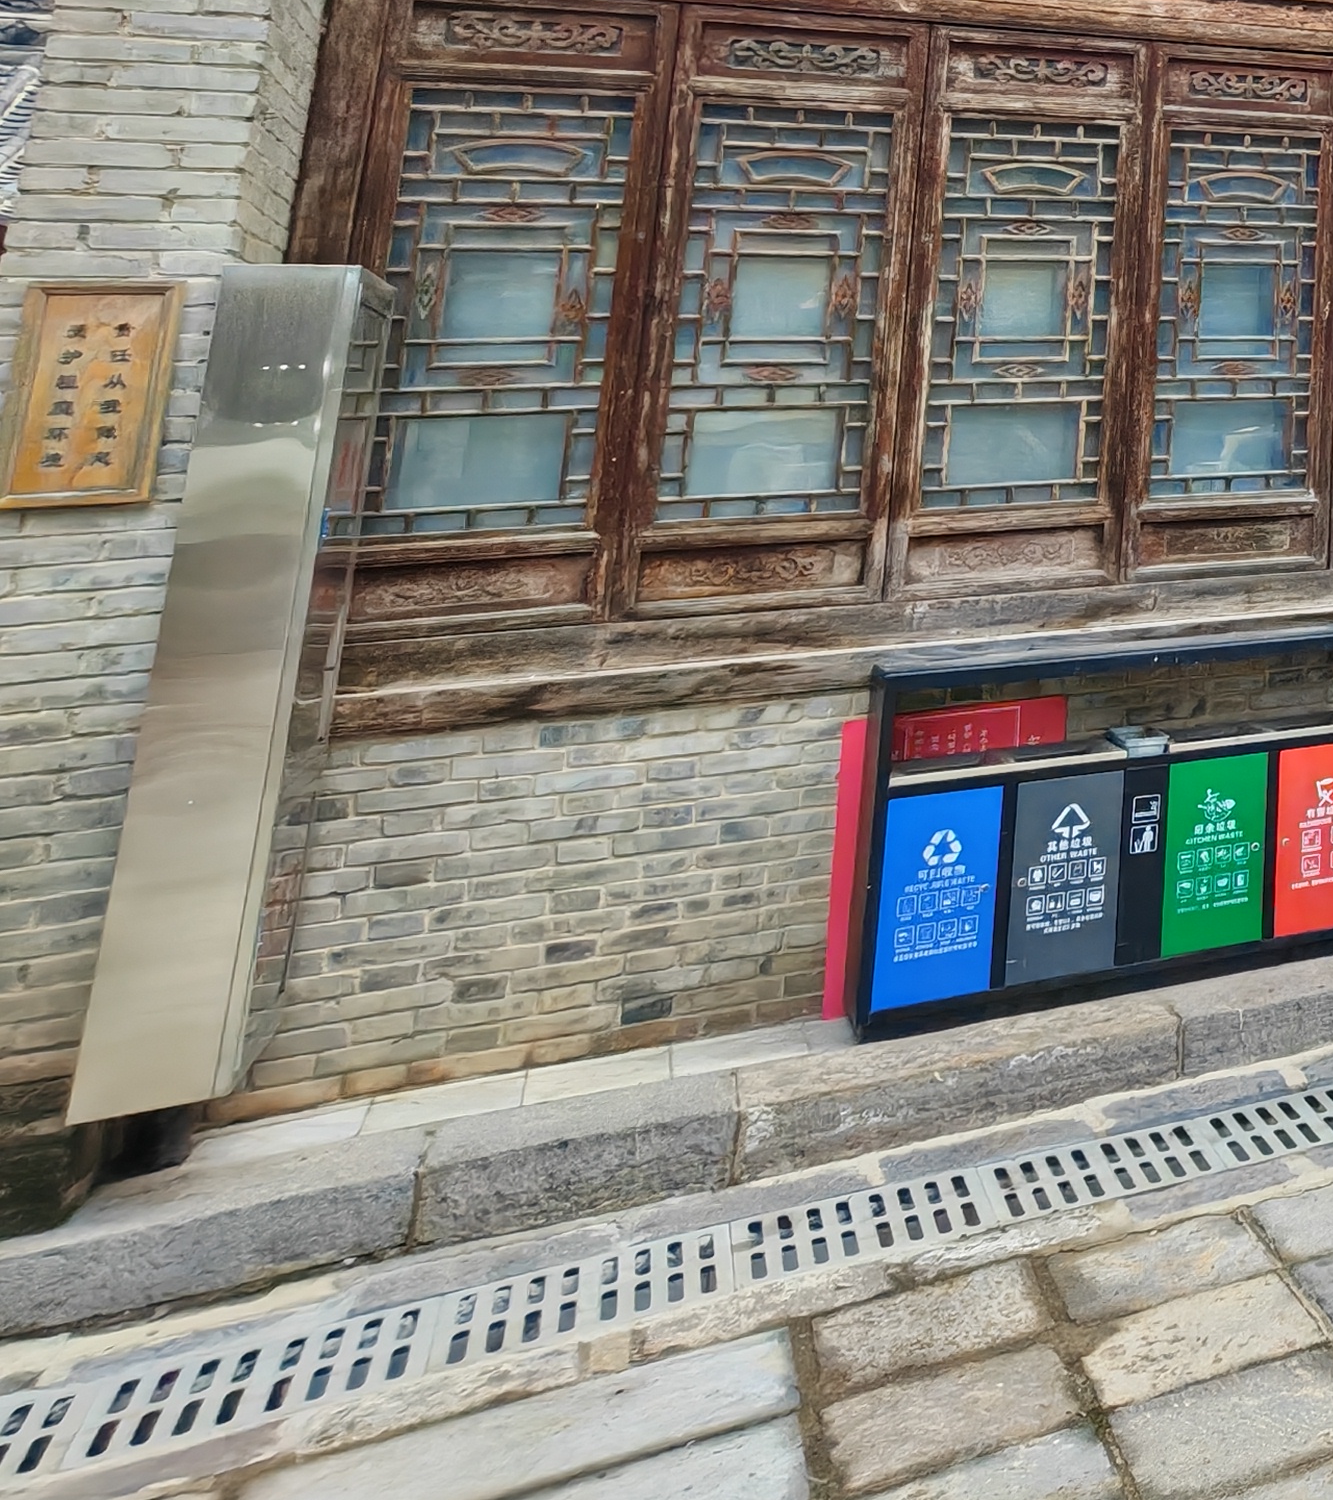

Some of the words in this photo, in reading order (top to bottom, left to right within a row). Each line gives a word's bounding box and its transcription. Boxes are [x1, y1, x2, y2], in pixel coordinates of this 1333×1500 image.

[1047, 836, 1092, 853] 其他垃圾
[1040, 852, 1067, 863] OTHER
[1069, 847, 1098, 859] WASTE
